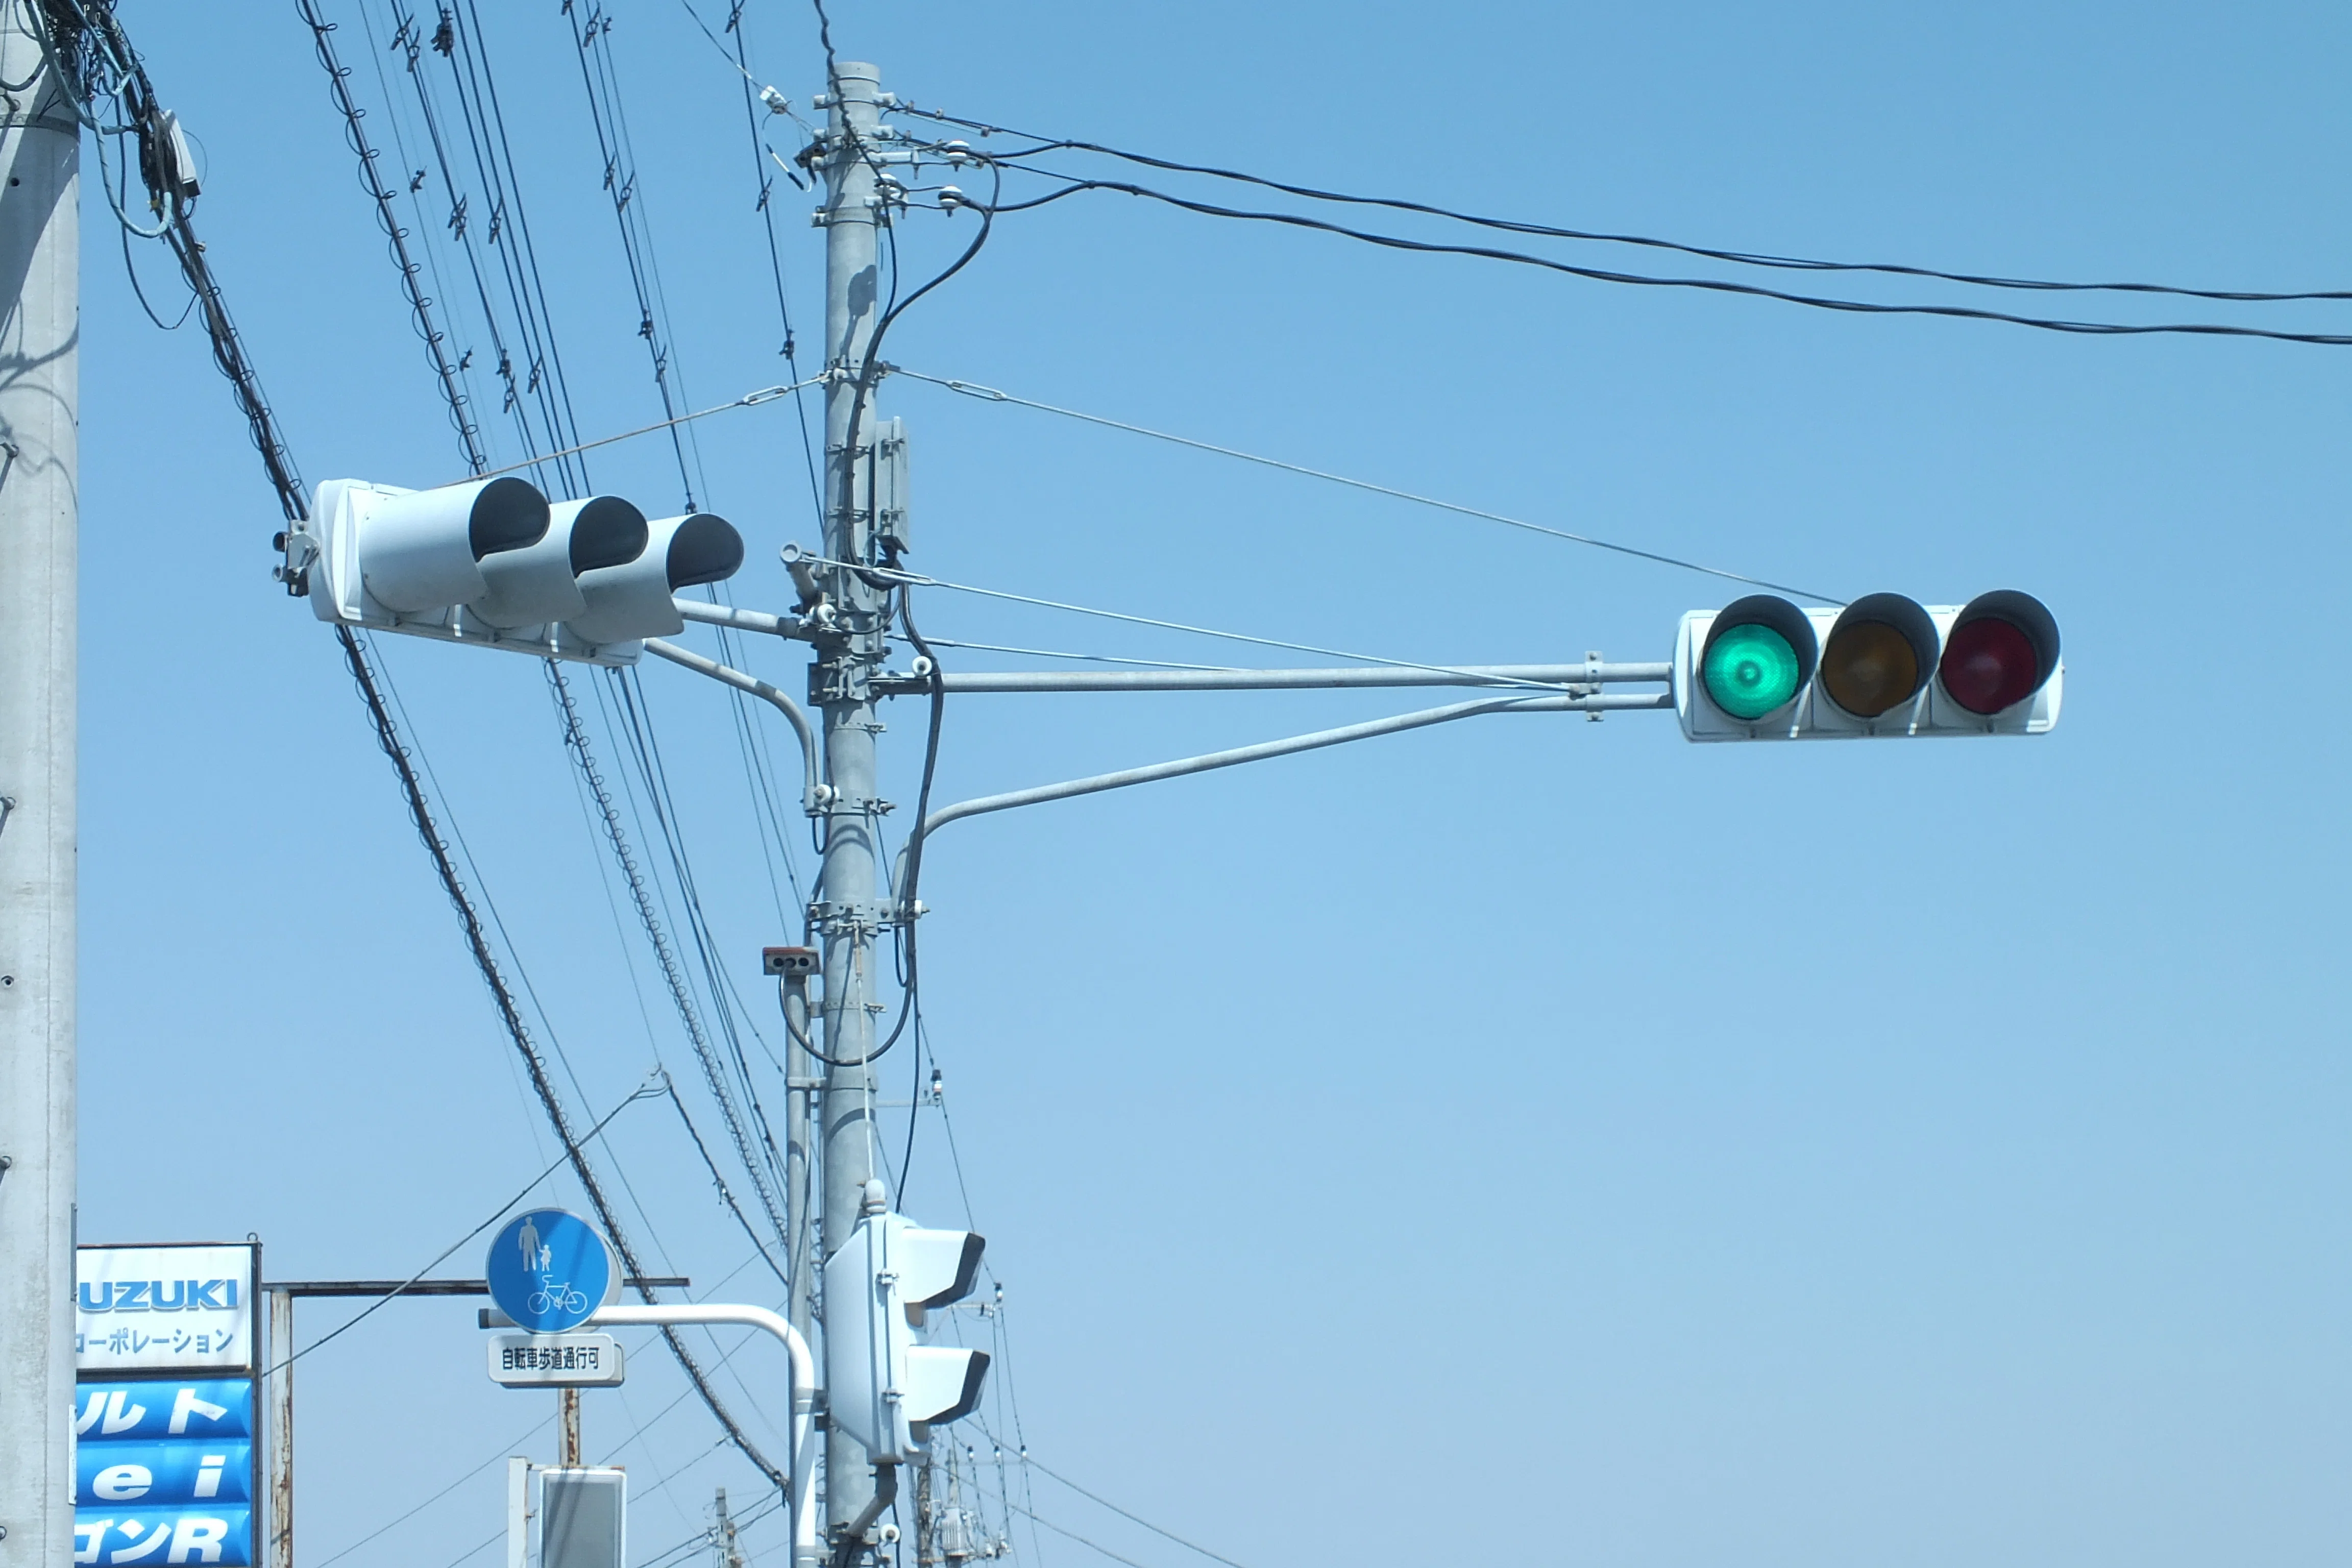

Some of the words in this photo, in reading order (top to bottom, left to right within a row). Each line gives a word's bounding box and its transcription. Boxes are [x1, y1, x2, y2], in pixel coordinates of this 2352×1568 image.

[502, 1346, 599, 1370] 自転車歩道通行可
[76, 1388, 227, 1434] ルト
